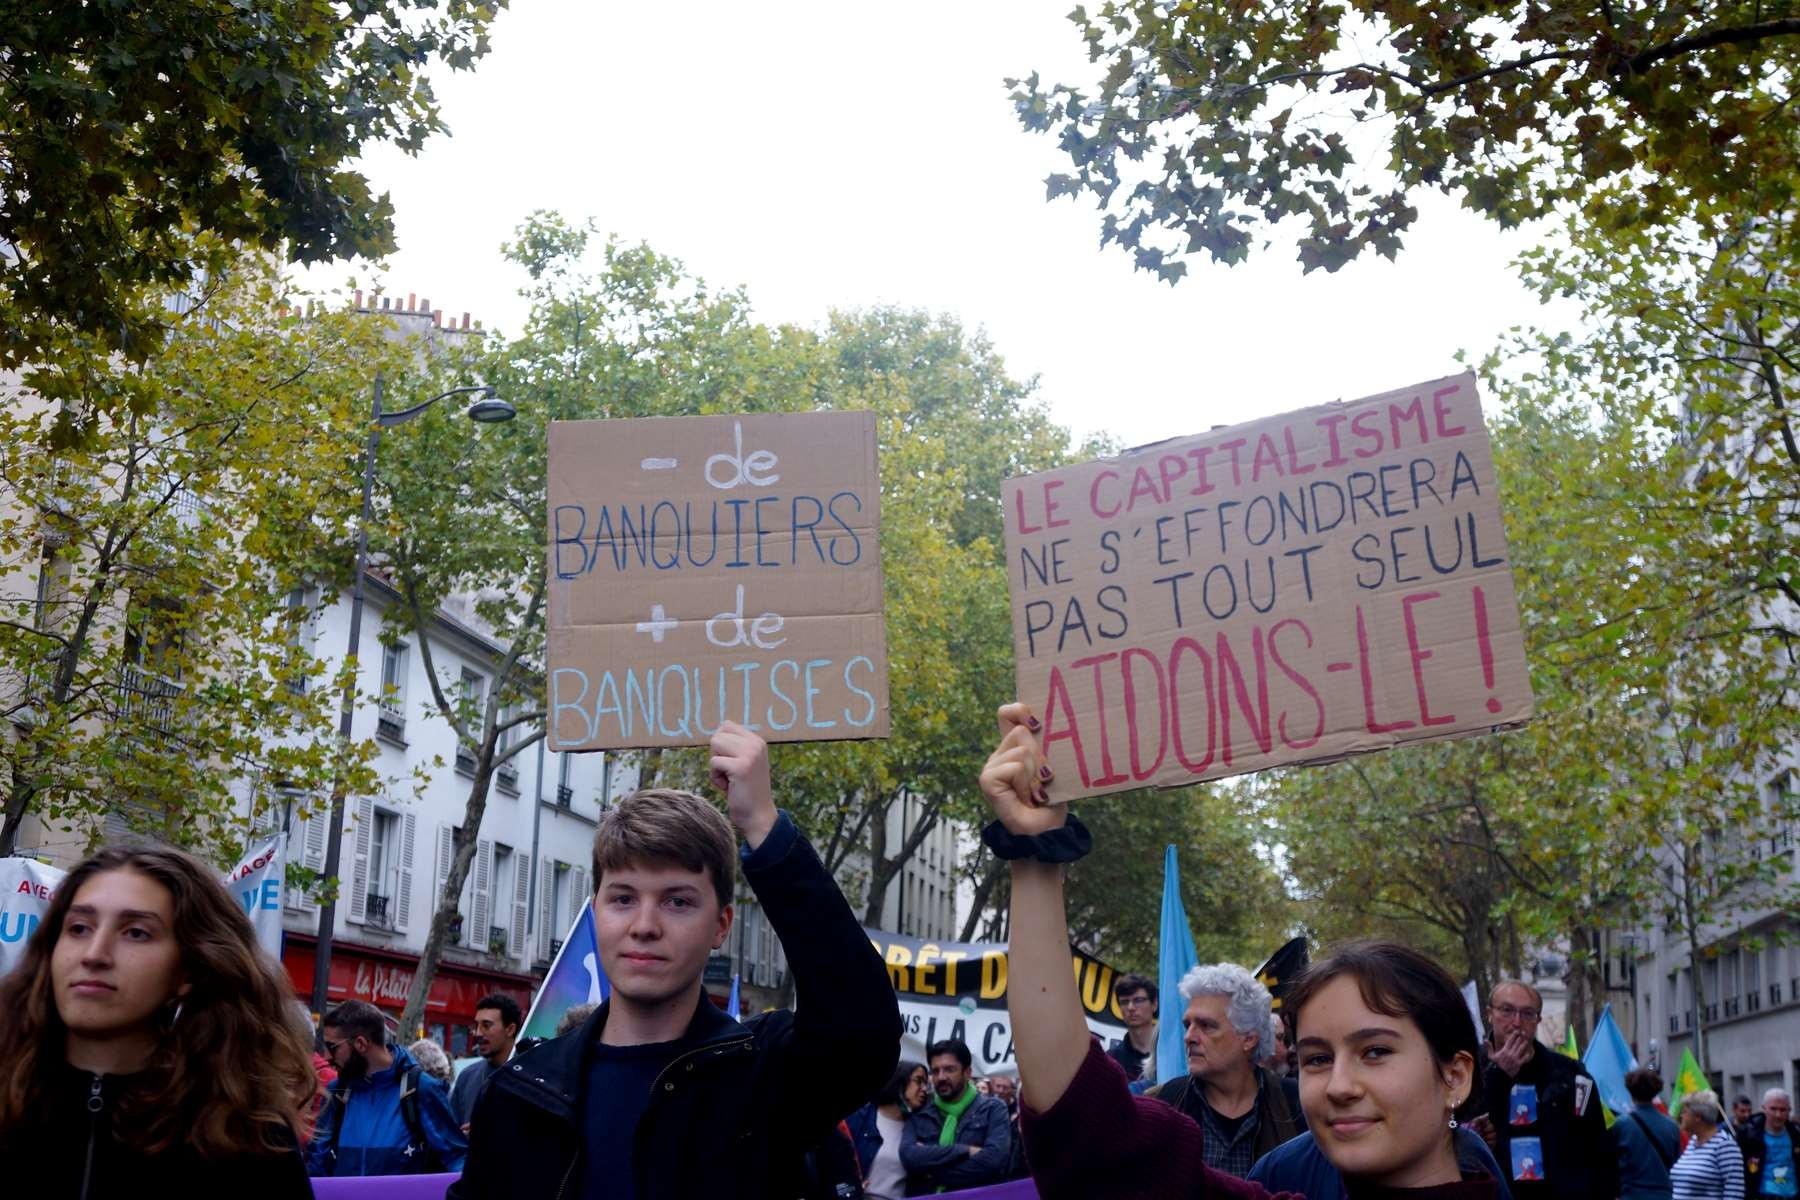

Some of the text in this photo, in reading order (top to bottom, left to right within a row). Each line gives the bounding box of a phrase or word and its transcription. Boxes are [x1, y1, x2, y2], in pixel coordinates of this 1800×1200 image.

[704, 420, 781, 489] de
[1015, 384, 1467, 535] LE CAPITALISME
[553, 491, 863, 580] BANQUIERS
[1020, 538, 1074, 591] NE
[635, 583, 788, 649] + de
[1023, 511, 1505, 659] PAS TOUT SEUL
[551, 655, 877, 746] BANQUISES
[372, 962, 413, 1002] Palett
[870, 940, 967, 996] RÊT
